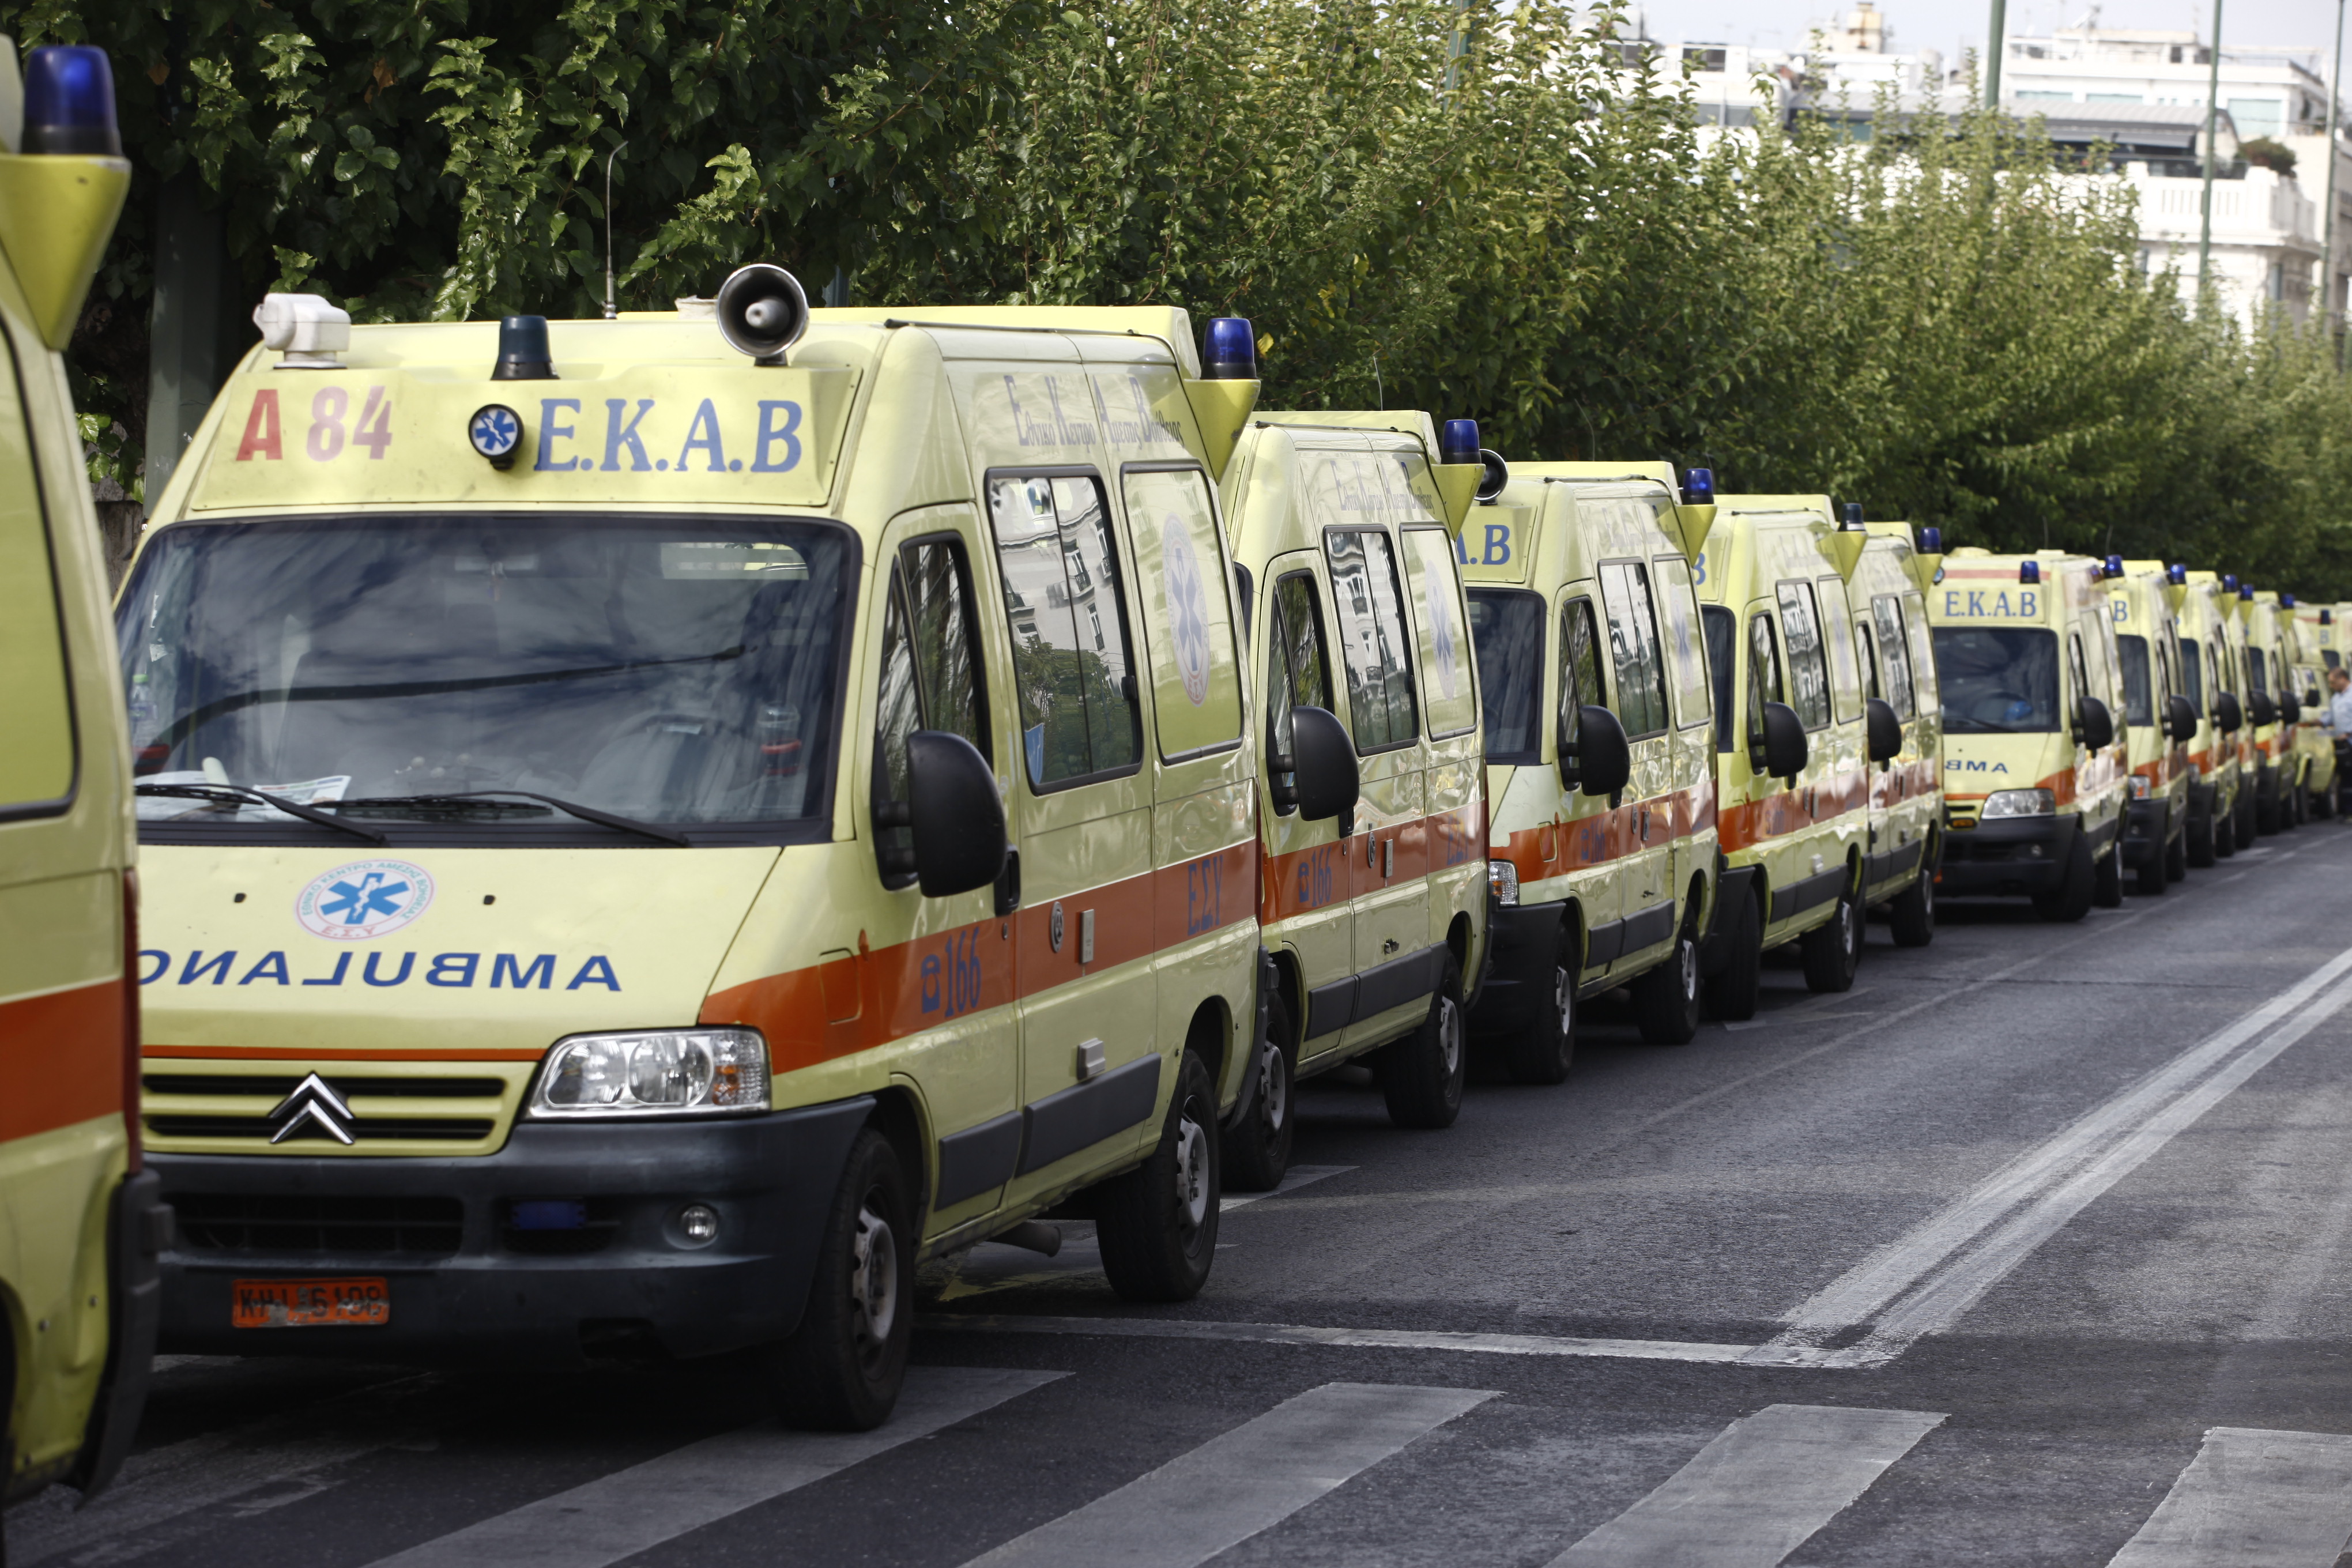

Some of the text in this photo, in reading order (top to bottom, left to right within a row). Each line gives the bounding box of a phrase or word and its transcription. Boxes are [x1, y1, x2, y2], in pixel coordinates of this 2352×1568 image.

[306, 385, 394, 461] 84
[321, 862, 373, 884] ΚΕΝΤΡΟ
[944, 926, 982, 1019] 166
